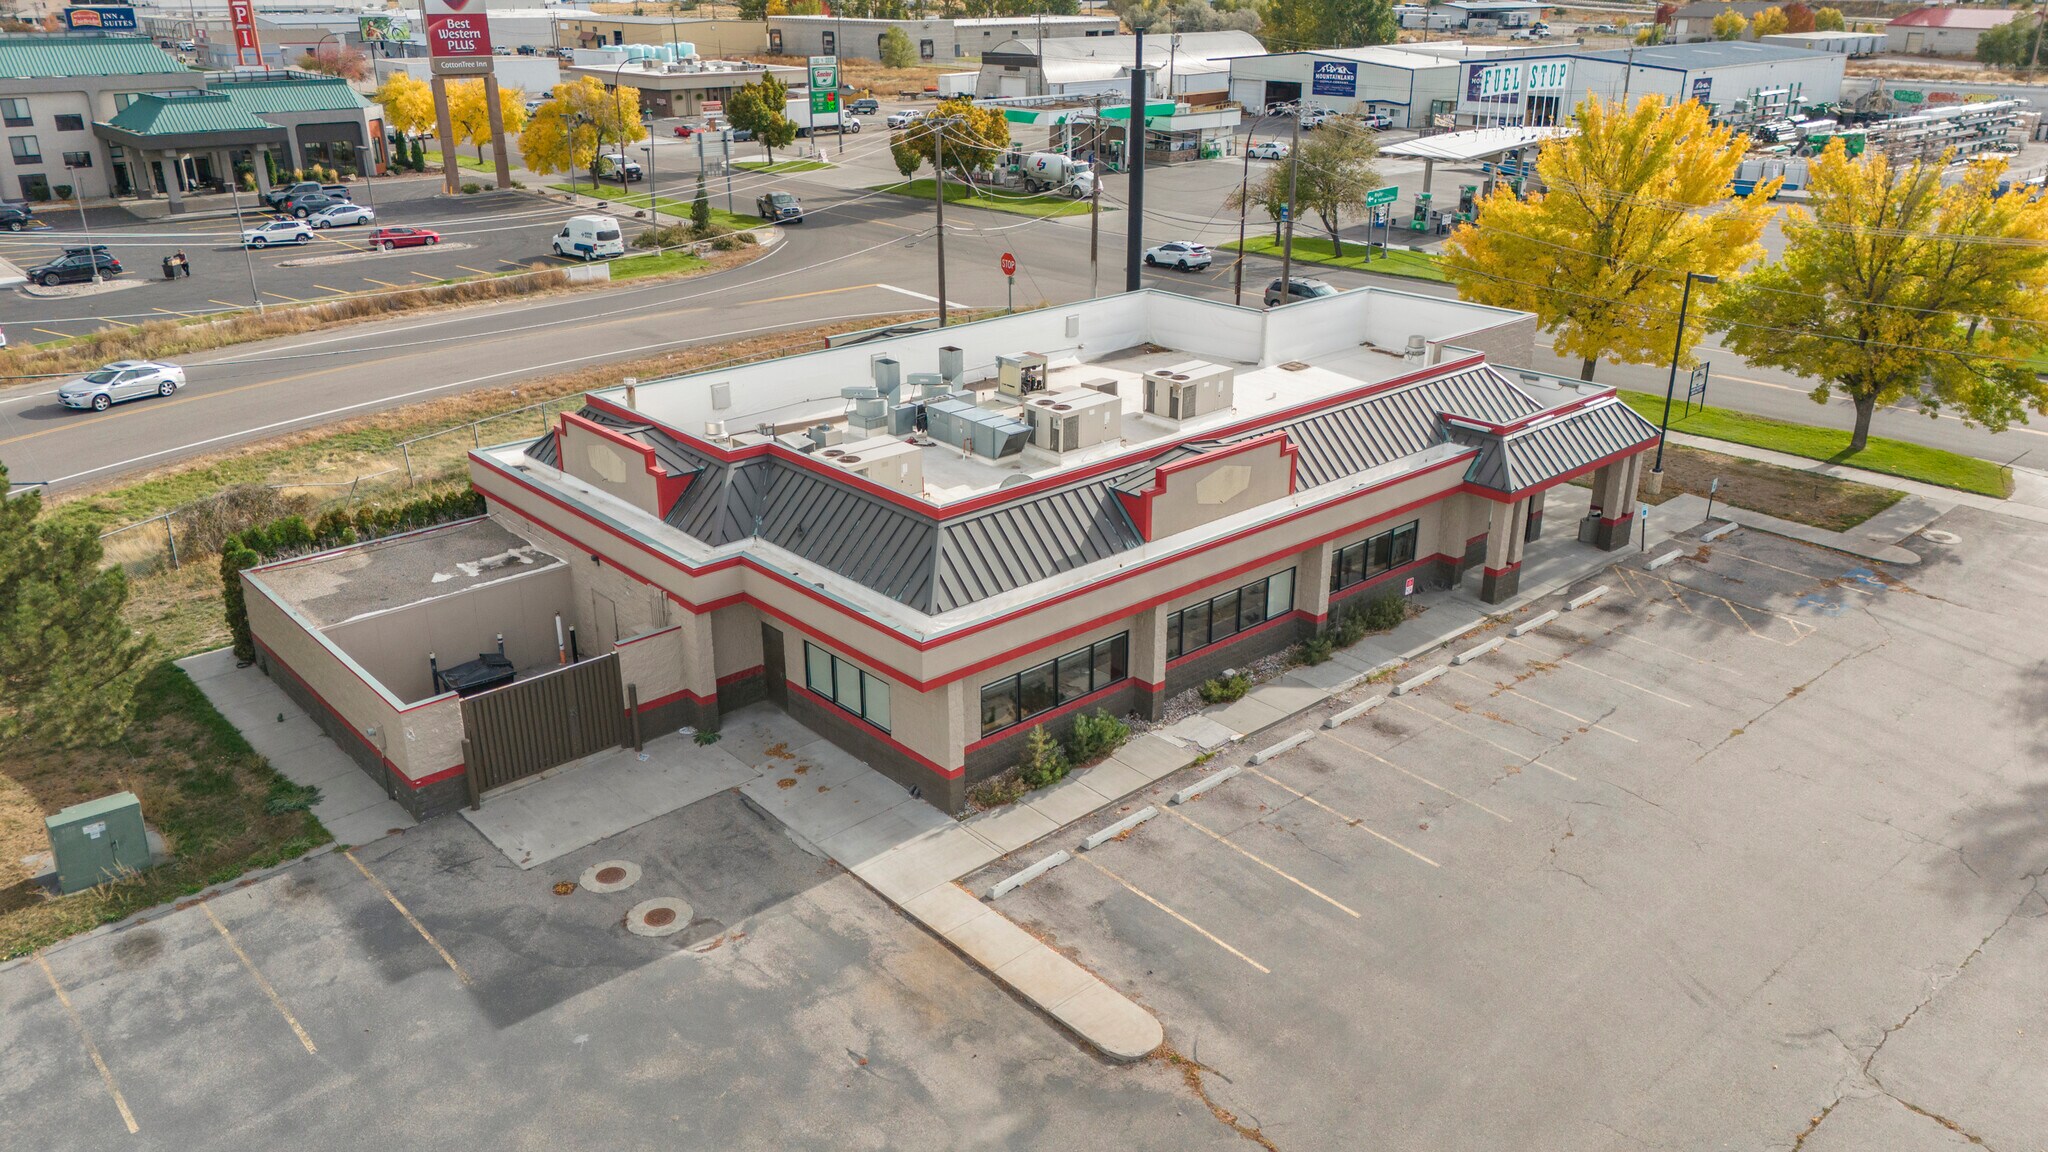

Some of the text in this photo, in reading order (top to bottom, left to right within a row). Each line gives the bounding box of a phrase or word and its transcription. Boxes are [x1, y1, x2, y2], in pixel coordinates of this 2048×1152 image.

[447, 18, 471, 29] Best
[438, 29, 481, 39] Western
[448, 40, 475, 50] PLUS
[441, 61, 476, 69] CottonTree
[1315, 73, 1355, 81] MOUNTAINLAND
[1483, 63, 1567, 94] FUEL STOP
[1002, 259, 1015, 269] STOP
